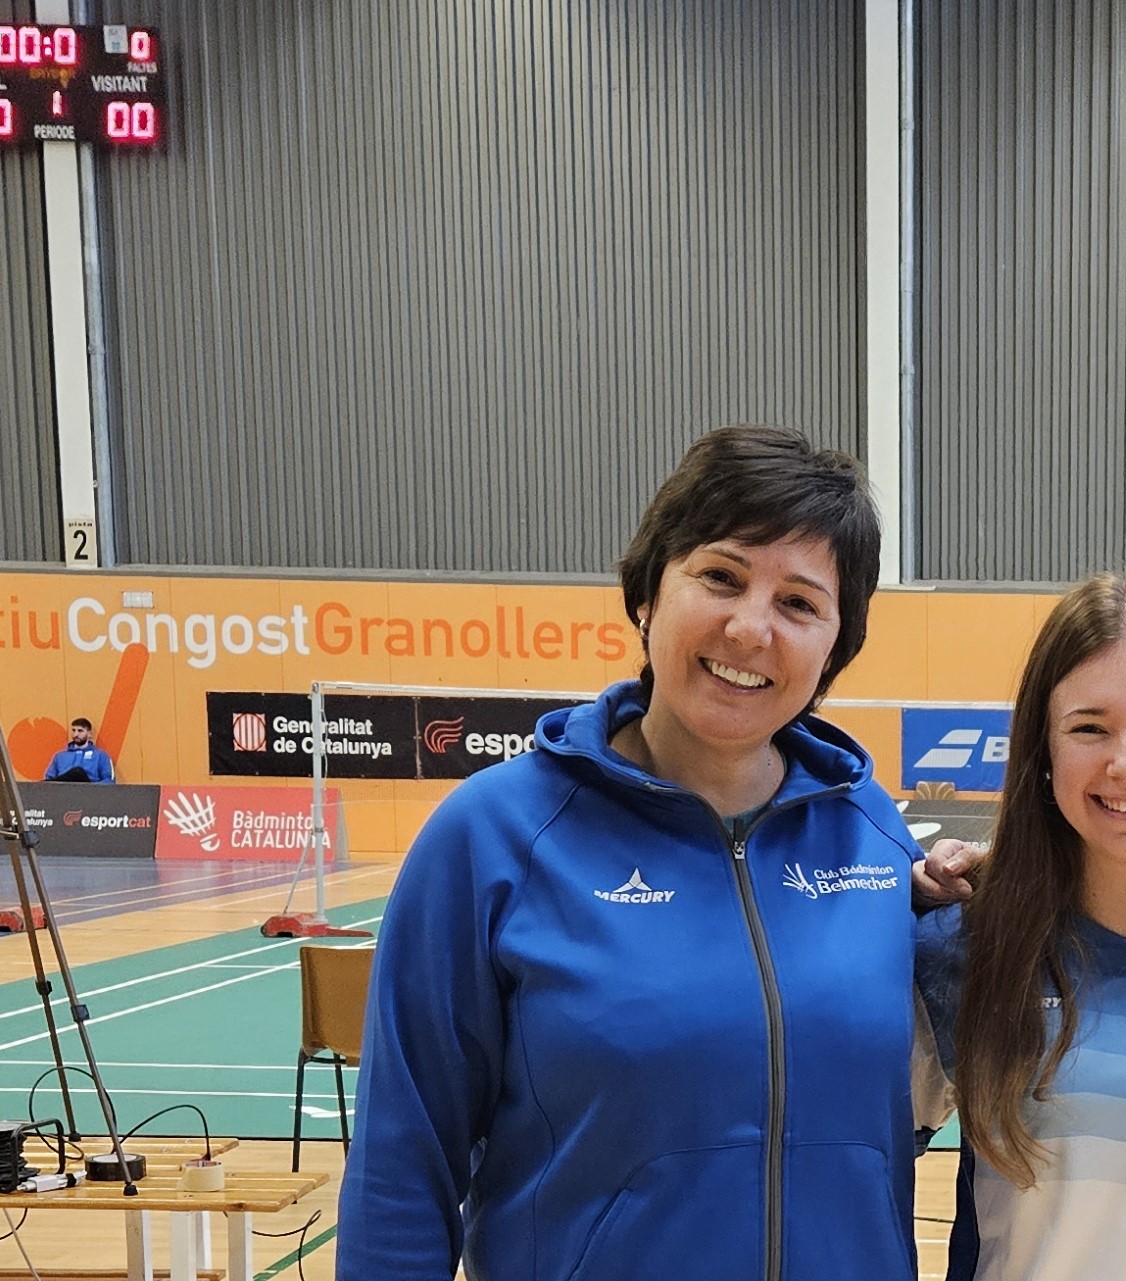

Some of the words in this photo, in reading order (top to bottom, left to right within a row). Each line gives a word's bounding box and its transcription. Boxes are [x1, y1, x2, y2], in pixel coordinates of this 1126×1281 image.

[131, 31, 150, 59] 0
[91, 75, 148, 92] VISITANT
[107, 101, 155, 138] 00
[34, 124, 76, 140] PERIODE
[73, 529, 88, 560] 2
[272, 716, 373, 735] Genralitat
[272, 736, 297, 753] de
[81, 814, 151, 830] esportcat
[232, 811, 325, 830] Bàdminto
[813, 869, 840, 880] Club
[816, 876, 898, 894] Belmecher
[593, 889, 676, 904] MERCURY
